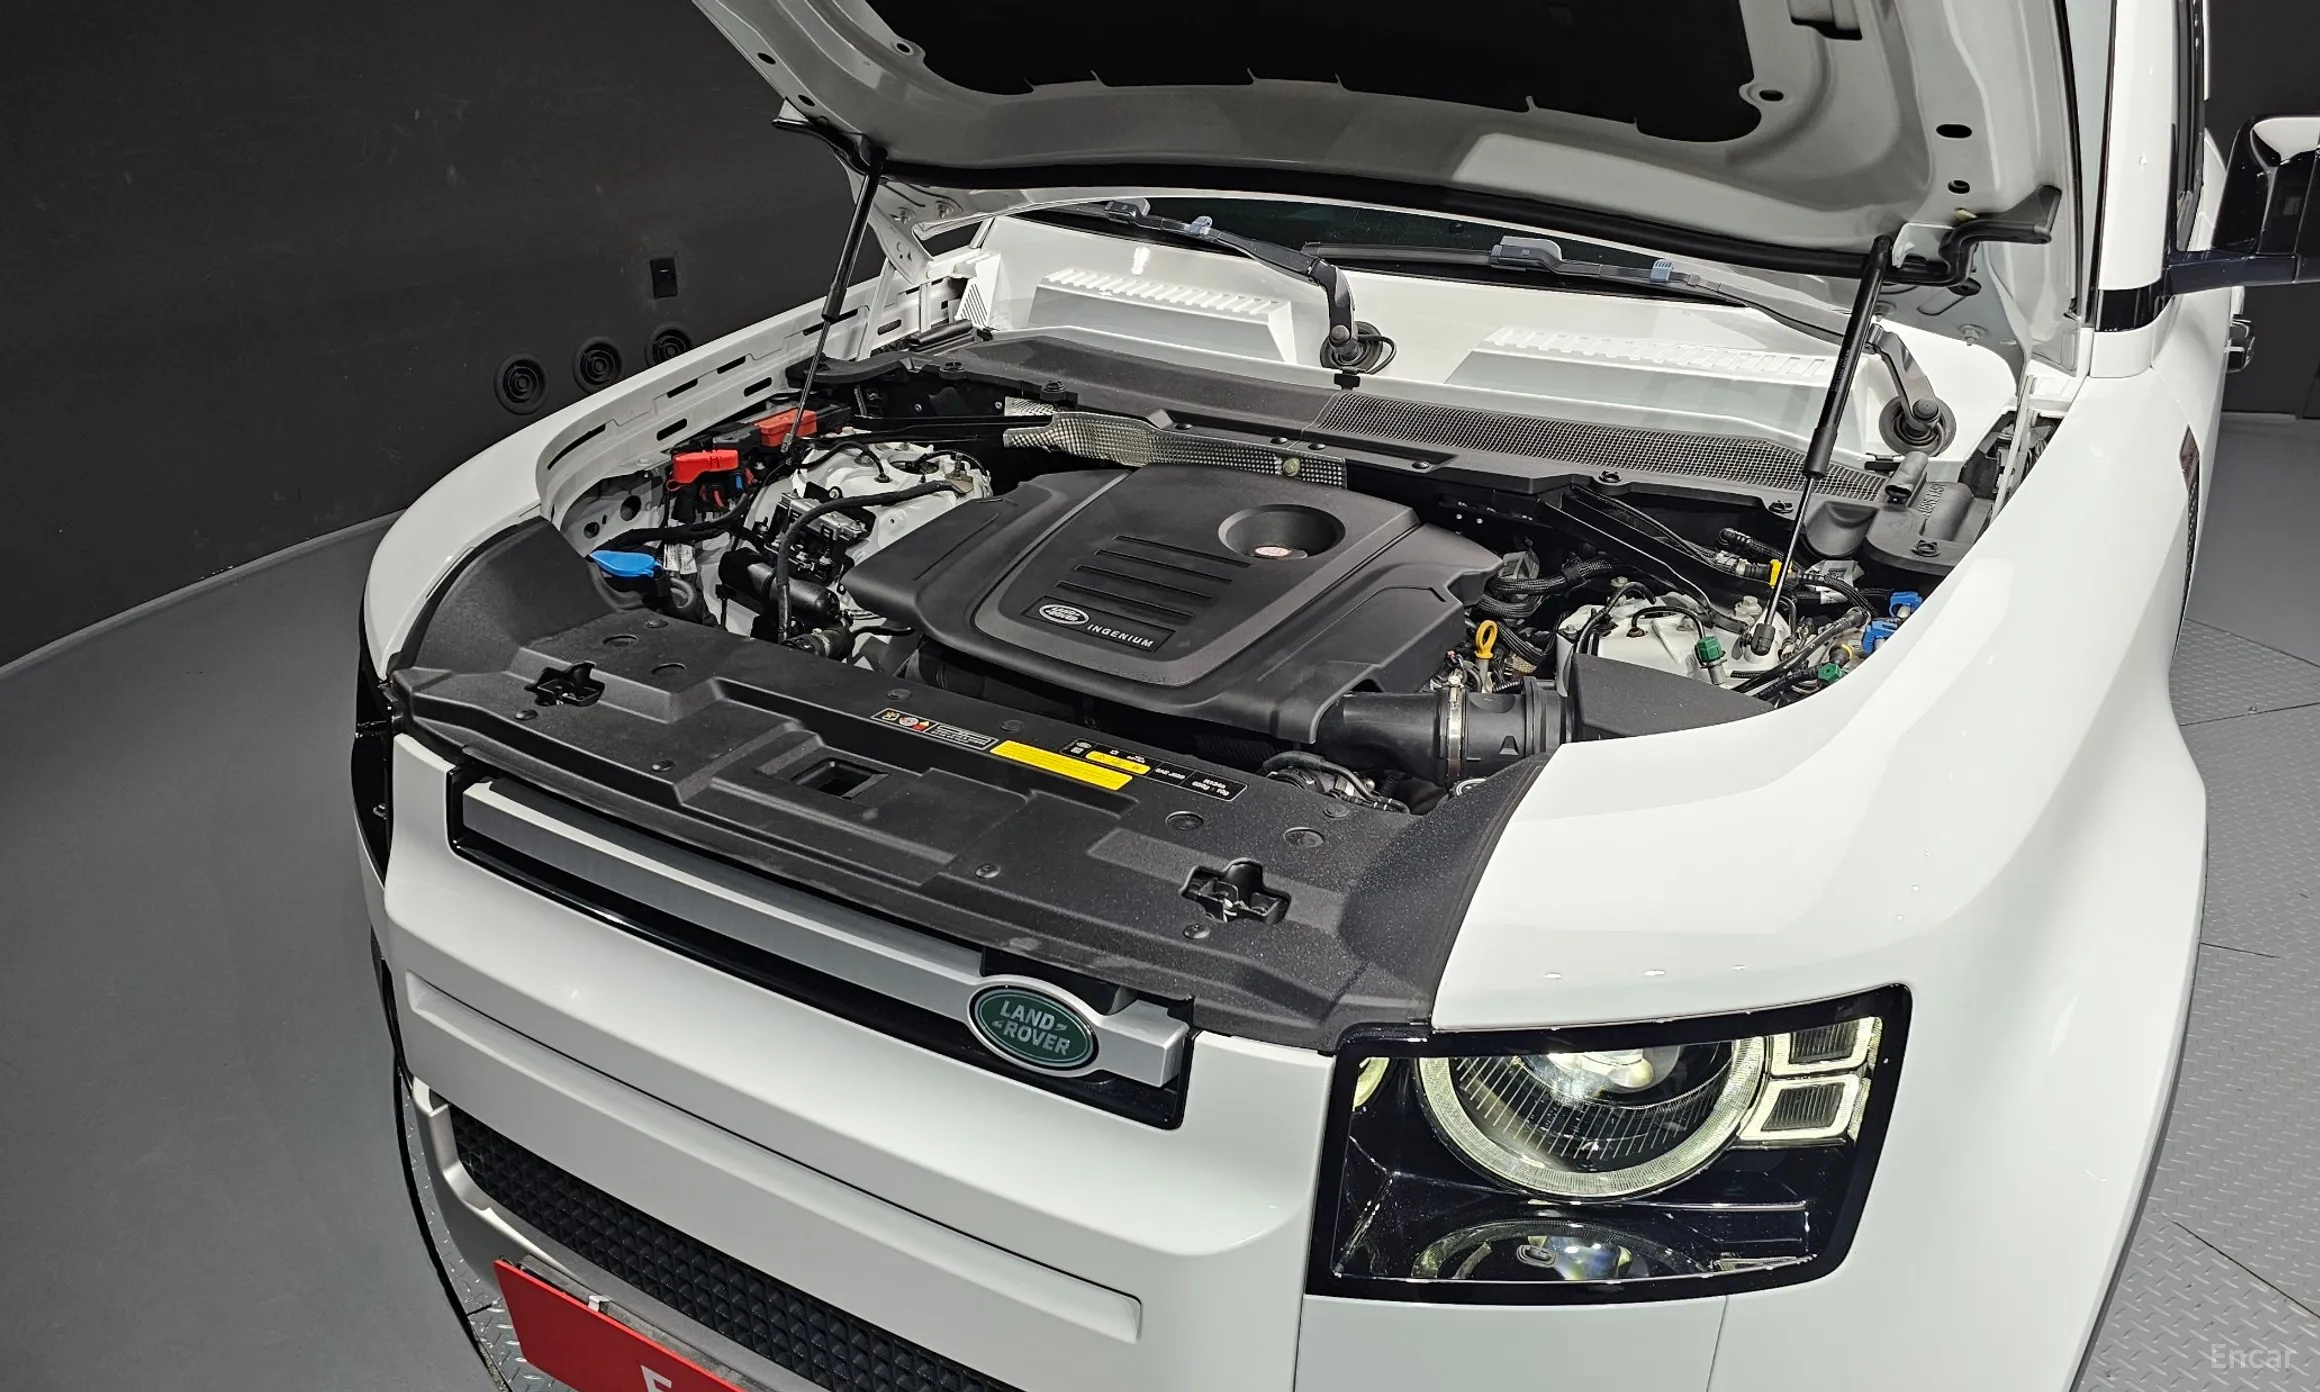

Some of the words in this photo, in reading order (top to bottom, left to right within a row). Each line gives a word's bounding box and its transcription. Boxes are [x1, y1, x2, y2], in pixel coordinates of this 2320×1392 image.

[1087, 624, 1154, 647] INGENIUM
[1000, 999, 1055, 1031] LAND
[1003, 1020, 1071, 1056] ROVER
